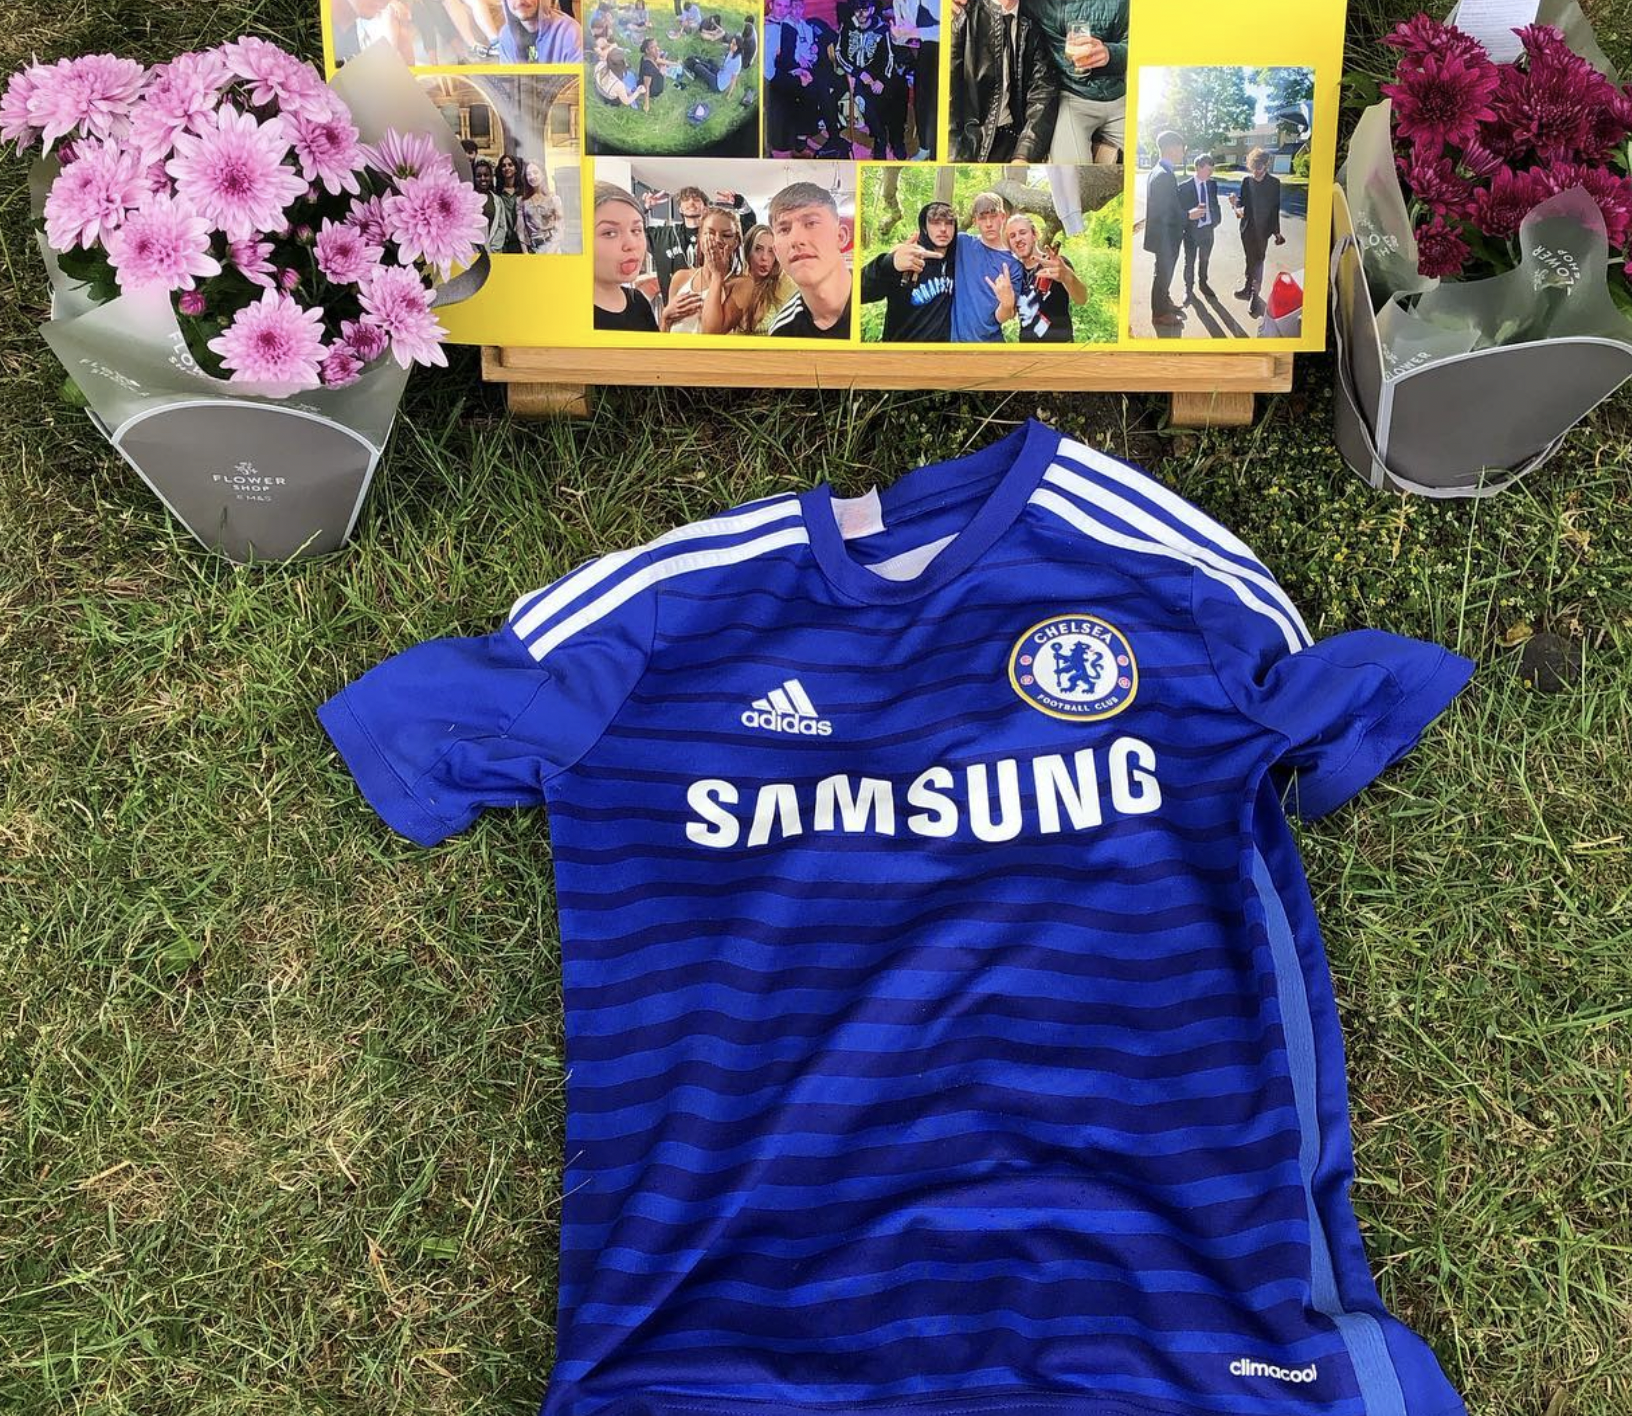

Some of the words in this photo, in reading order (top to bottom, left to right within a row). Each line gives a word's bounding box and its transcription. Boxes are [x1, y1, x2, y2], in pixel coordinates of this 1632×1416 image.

[212, 474, 286, 485] FLOWER
[232, 484, 270, 492] SHOP
[1034, 621, 1113, 645] CHELSEA
[1037, 694, 1090, 712] FOOTBALL
[1094, 696, 1119, 711] CLUB
[741, 709, 833, 736] adidas
[685, 736, 1163, 849] SAMSUNG
[1229, 1358, 1317, 1383] climacool
